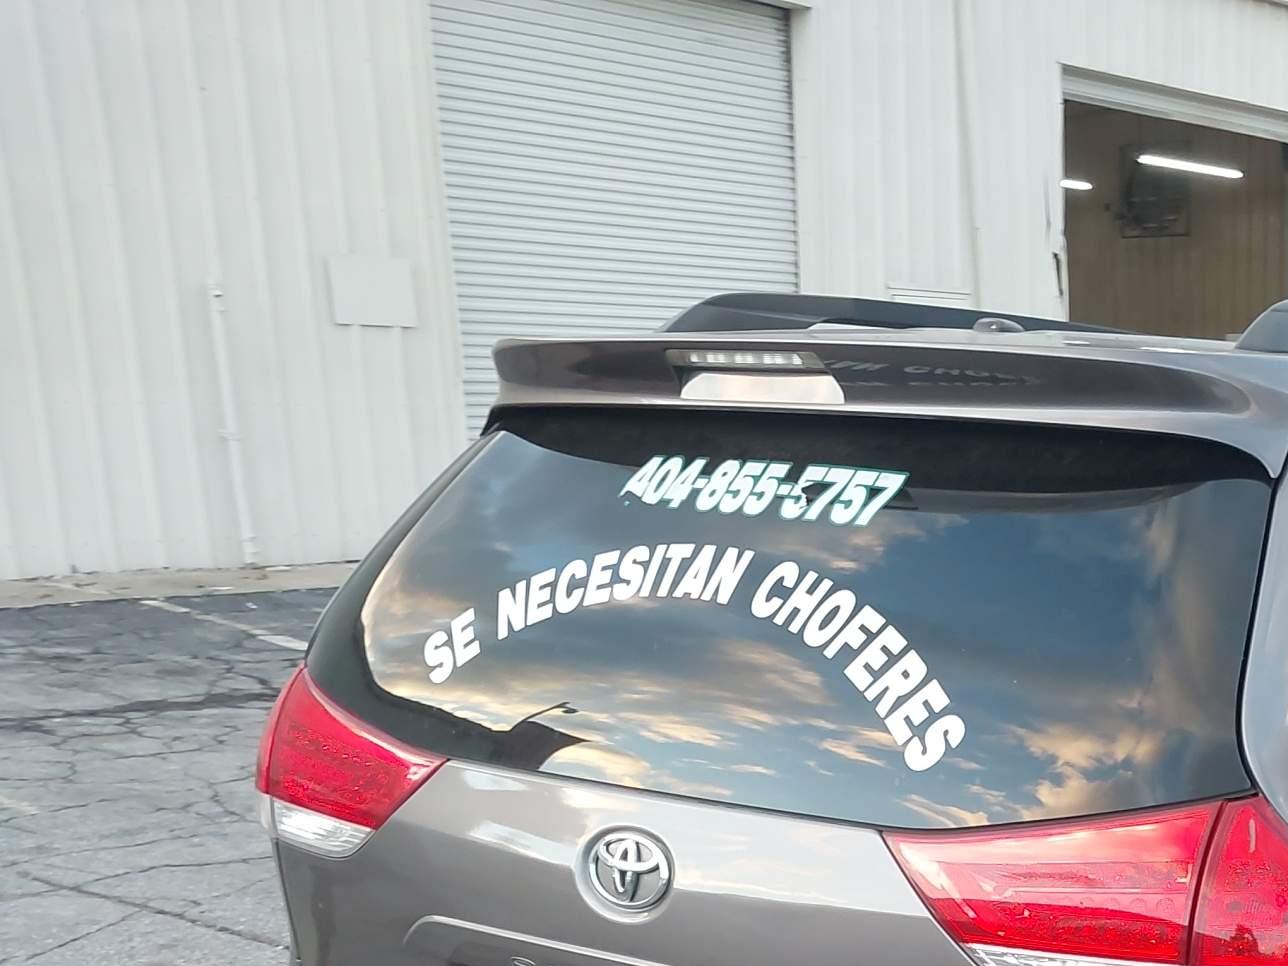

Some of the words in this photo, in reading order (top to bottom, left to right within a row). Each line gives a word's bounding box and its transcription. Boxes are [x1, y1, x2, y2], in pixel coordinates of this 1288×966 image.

[619, 456, 908, 526] 404-855-5757
[424, 607, 481, 684] SE
[497, 543, 754, 640] NECESITAN
[751, 560, 967, 771] CHOFERES
